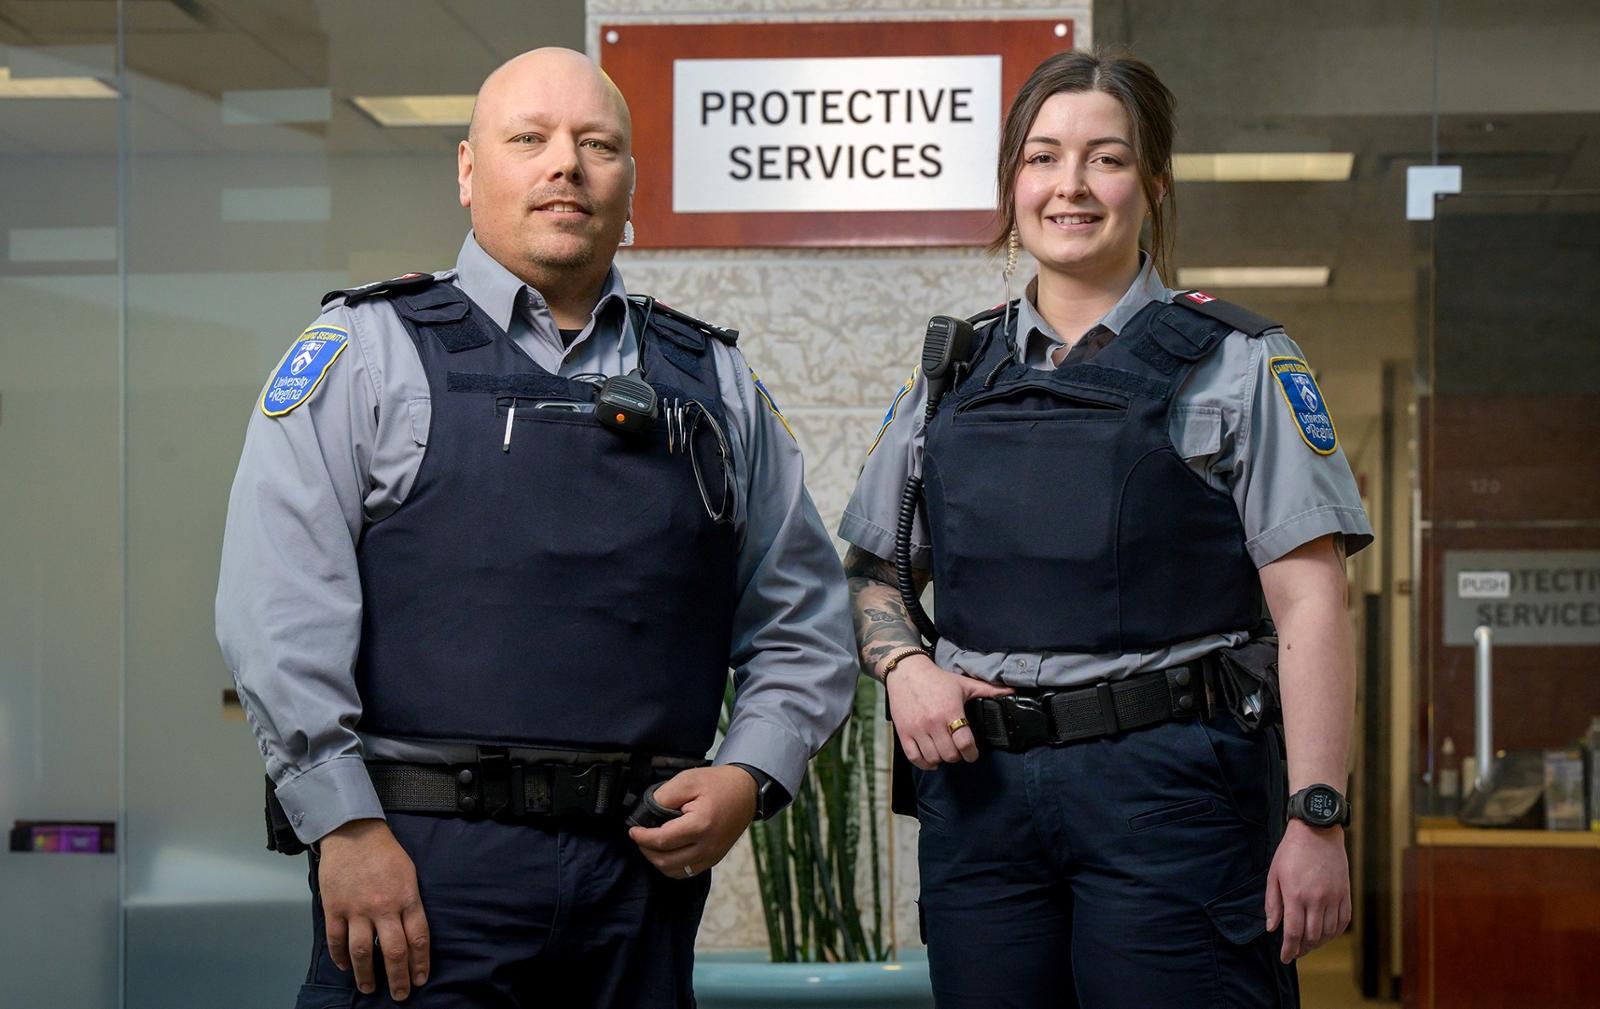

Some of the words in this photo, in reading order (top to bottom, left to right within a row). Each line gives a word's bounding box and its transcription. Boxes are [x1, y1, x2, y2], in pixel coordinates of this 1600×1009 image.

[701, 88, 973, 126] PROTECTIVE
[729, 144, 942, 180] SERVICES
[274, 376, 311, 388] University
[272, 387, 302, 404] Regina
[1299, 412, 1330, 427] University
[1309, 423, 1335, 442] Regina
[1462, 577, 1506, 592] PUSH
[1477, 603, 1600, 628] SERVICE
